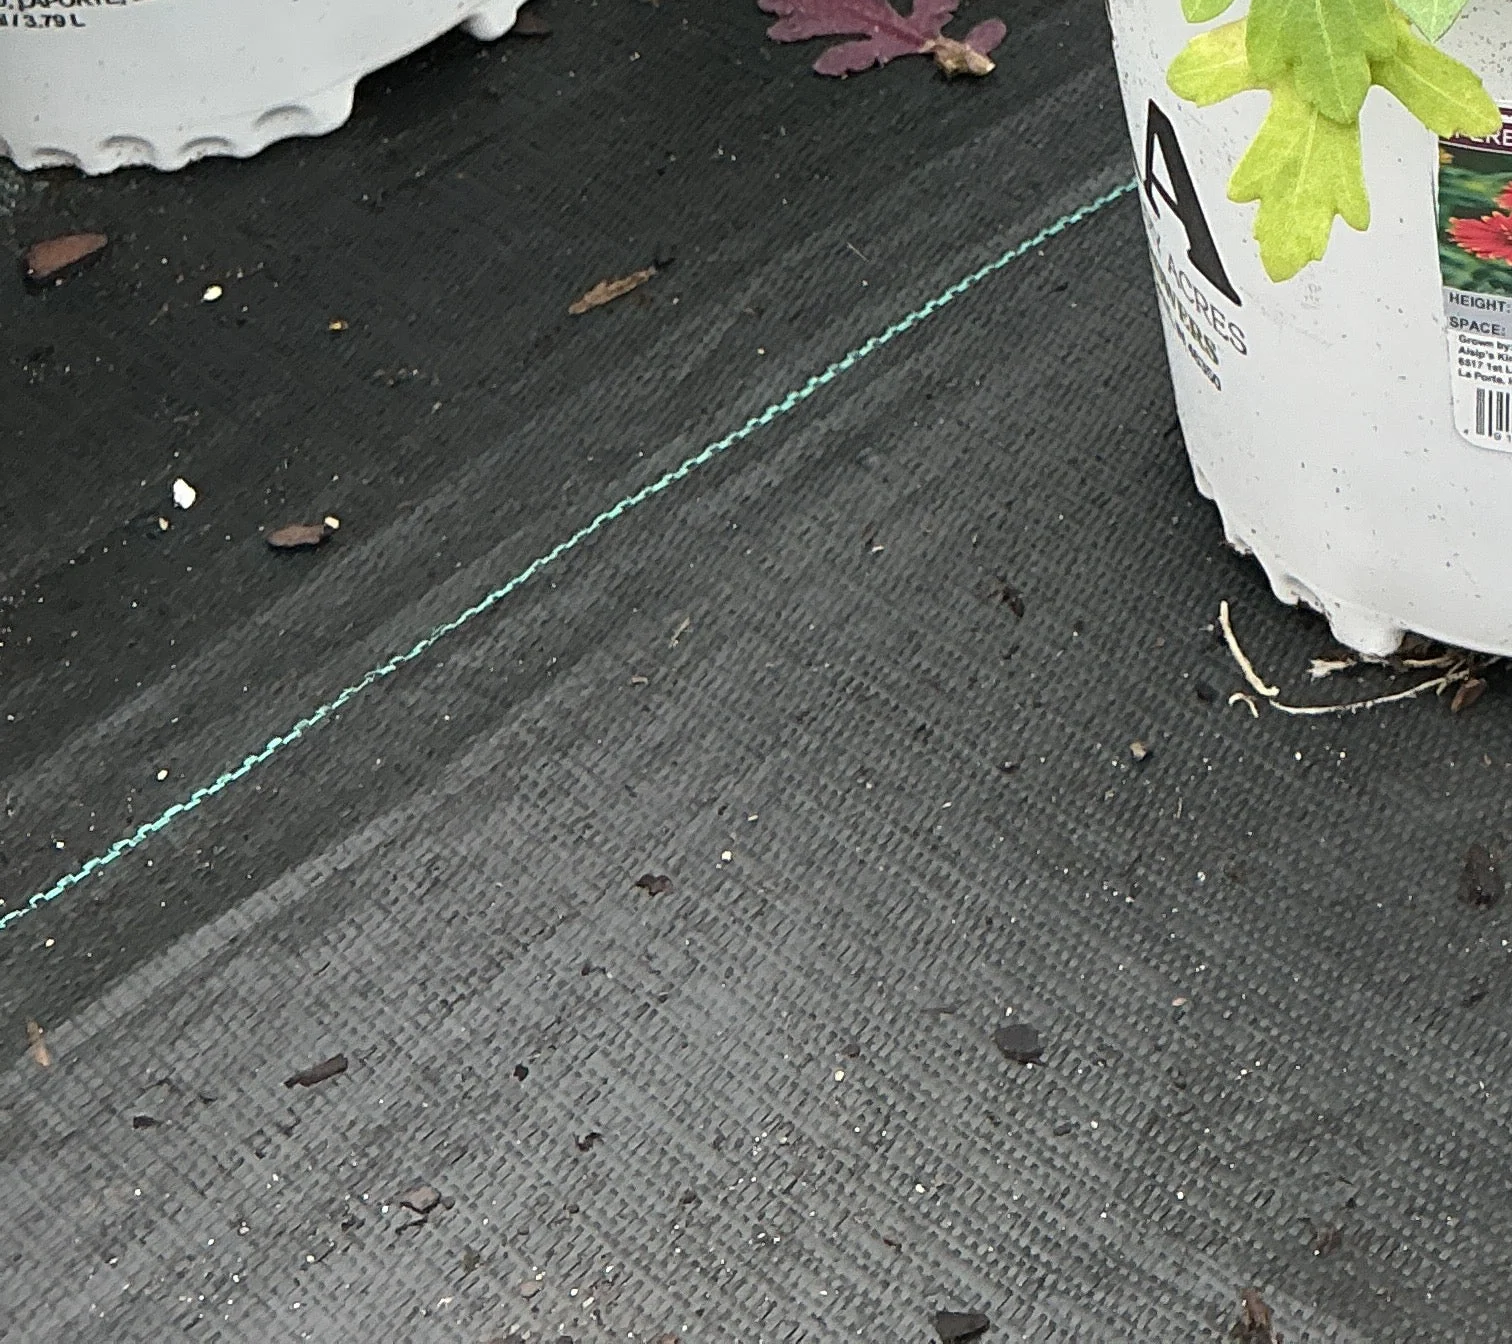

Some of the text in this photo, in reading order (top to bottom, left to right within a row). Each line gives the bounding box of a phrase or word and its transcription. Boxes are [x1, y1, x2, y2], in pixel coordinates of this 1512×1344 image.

[23, 14, 66, 29] 3.79
[70, 13, 86, 28] L
[1168, 253, 1248, 356] ACRES
[1449, 292, 1511, 313] HEIGHT:
[1449, 316, 1506, 336] SPACE:
[1458, 333, 1494, 347] Grown
